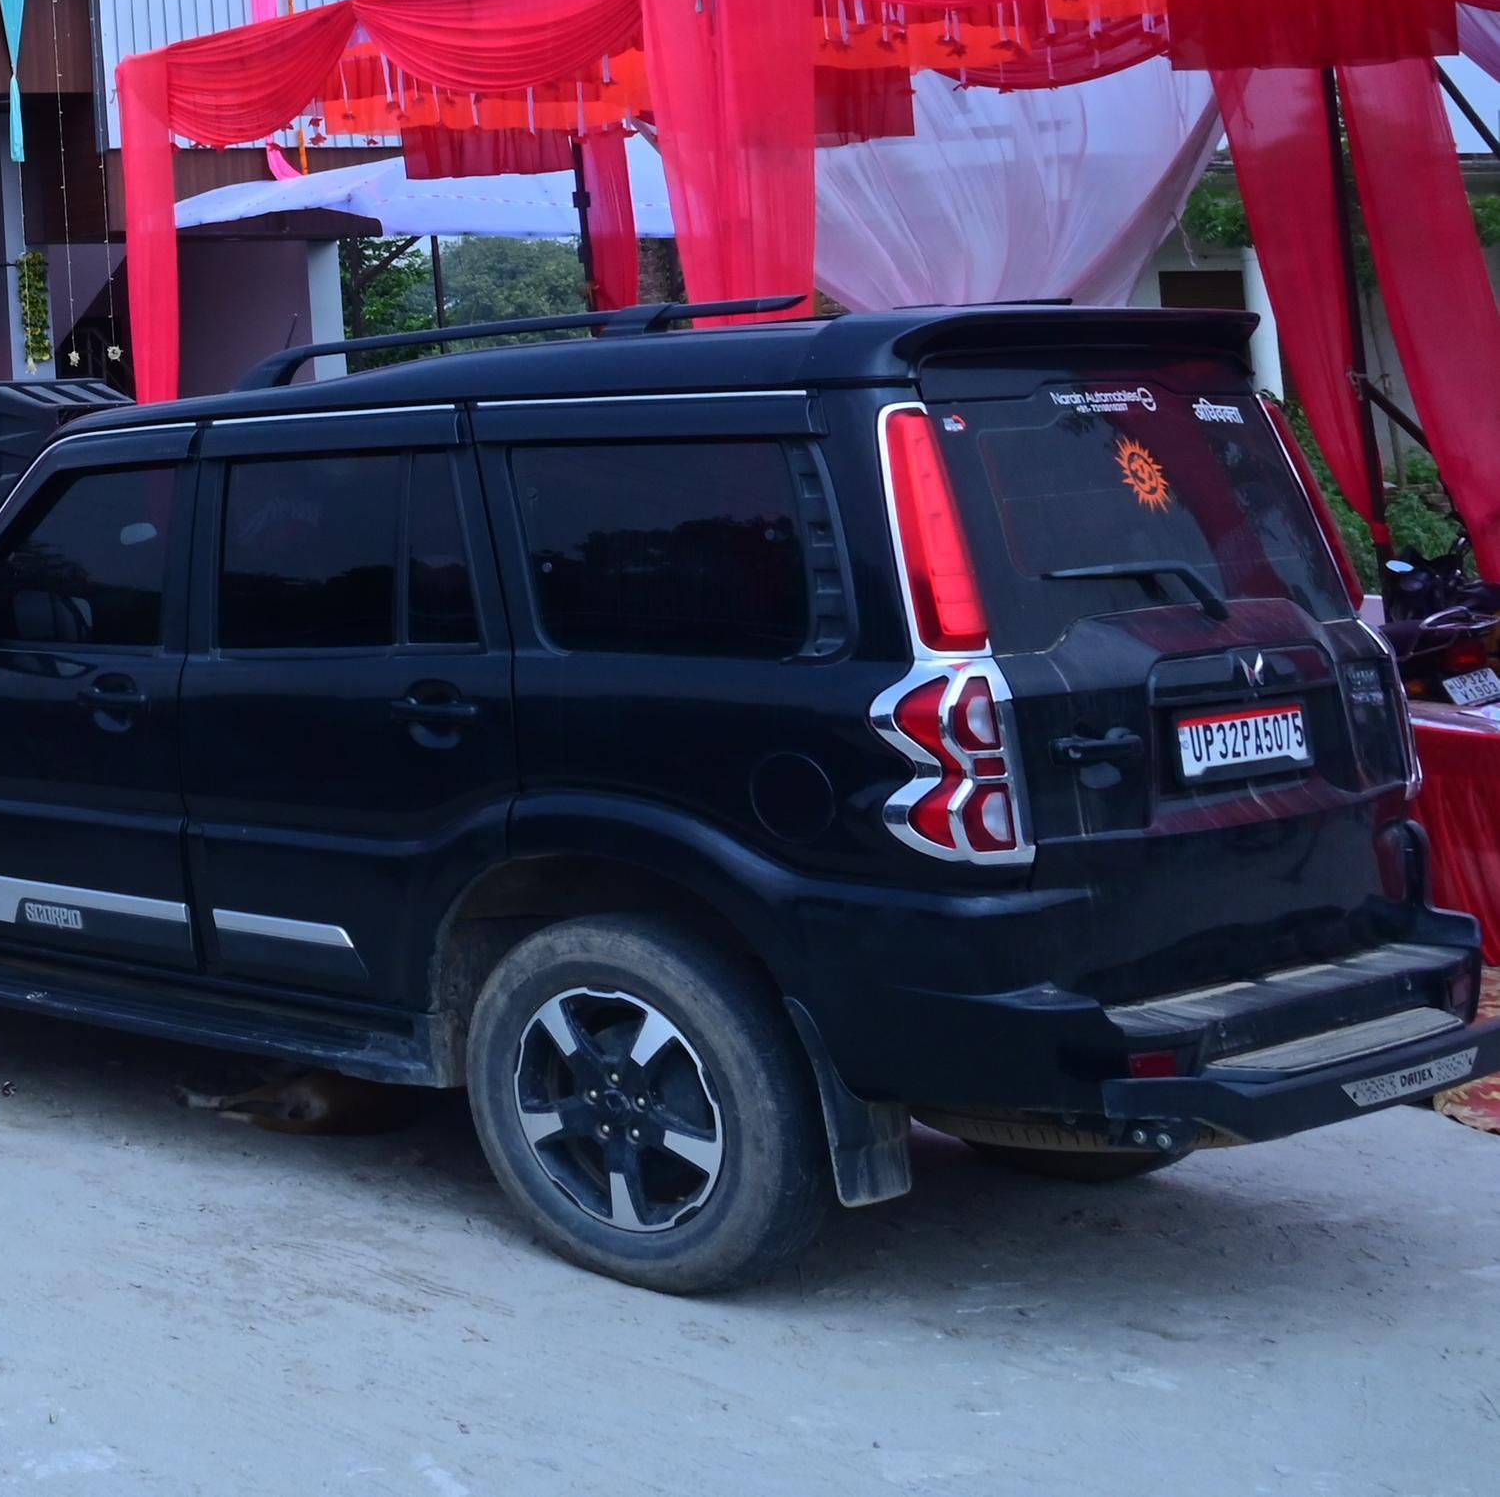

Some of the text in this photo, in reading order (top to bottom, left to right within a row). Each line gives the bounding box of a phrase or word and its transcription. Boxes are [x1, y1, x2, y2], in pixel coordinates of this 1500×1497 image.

[1085, 389, 1140, 403] Automobiles
[1189, 712, 1304, 762] UP32PA5075
[25, 903, 82, 929] SCORPIO
